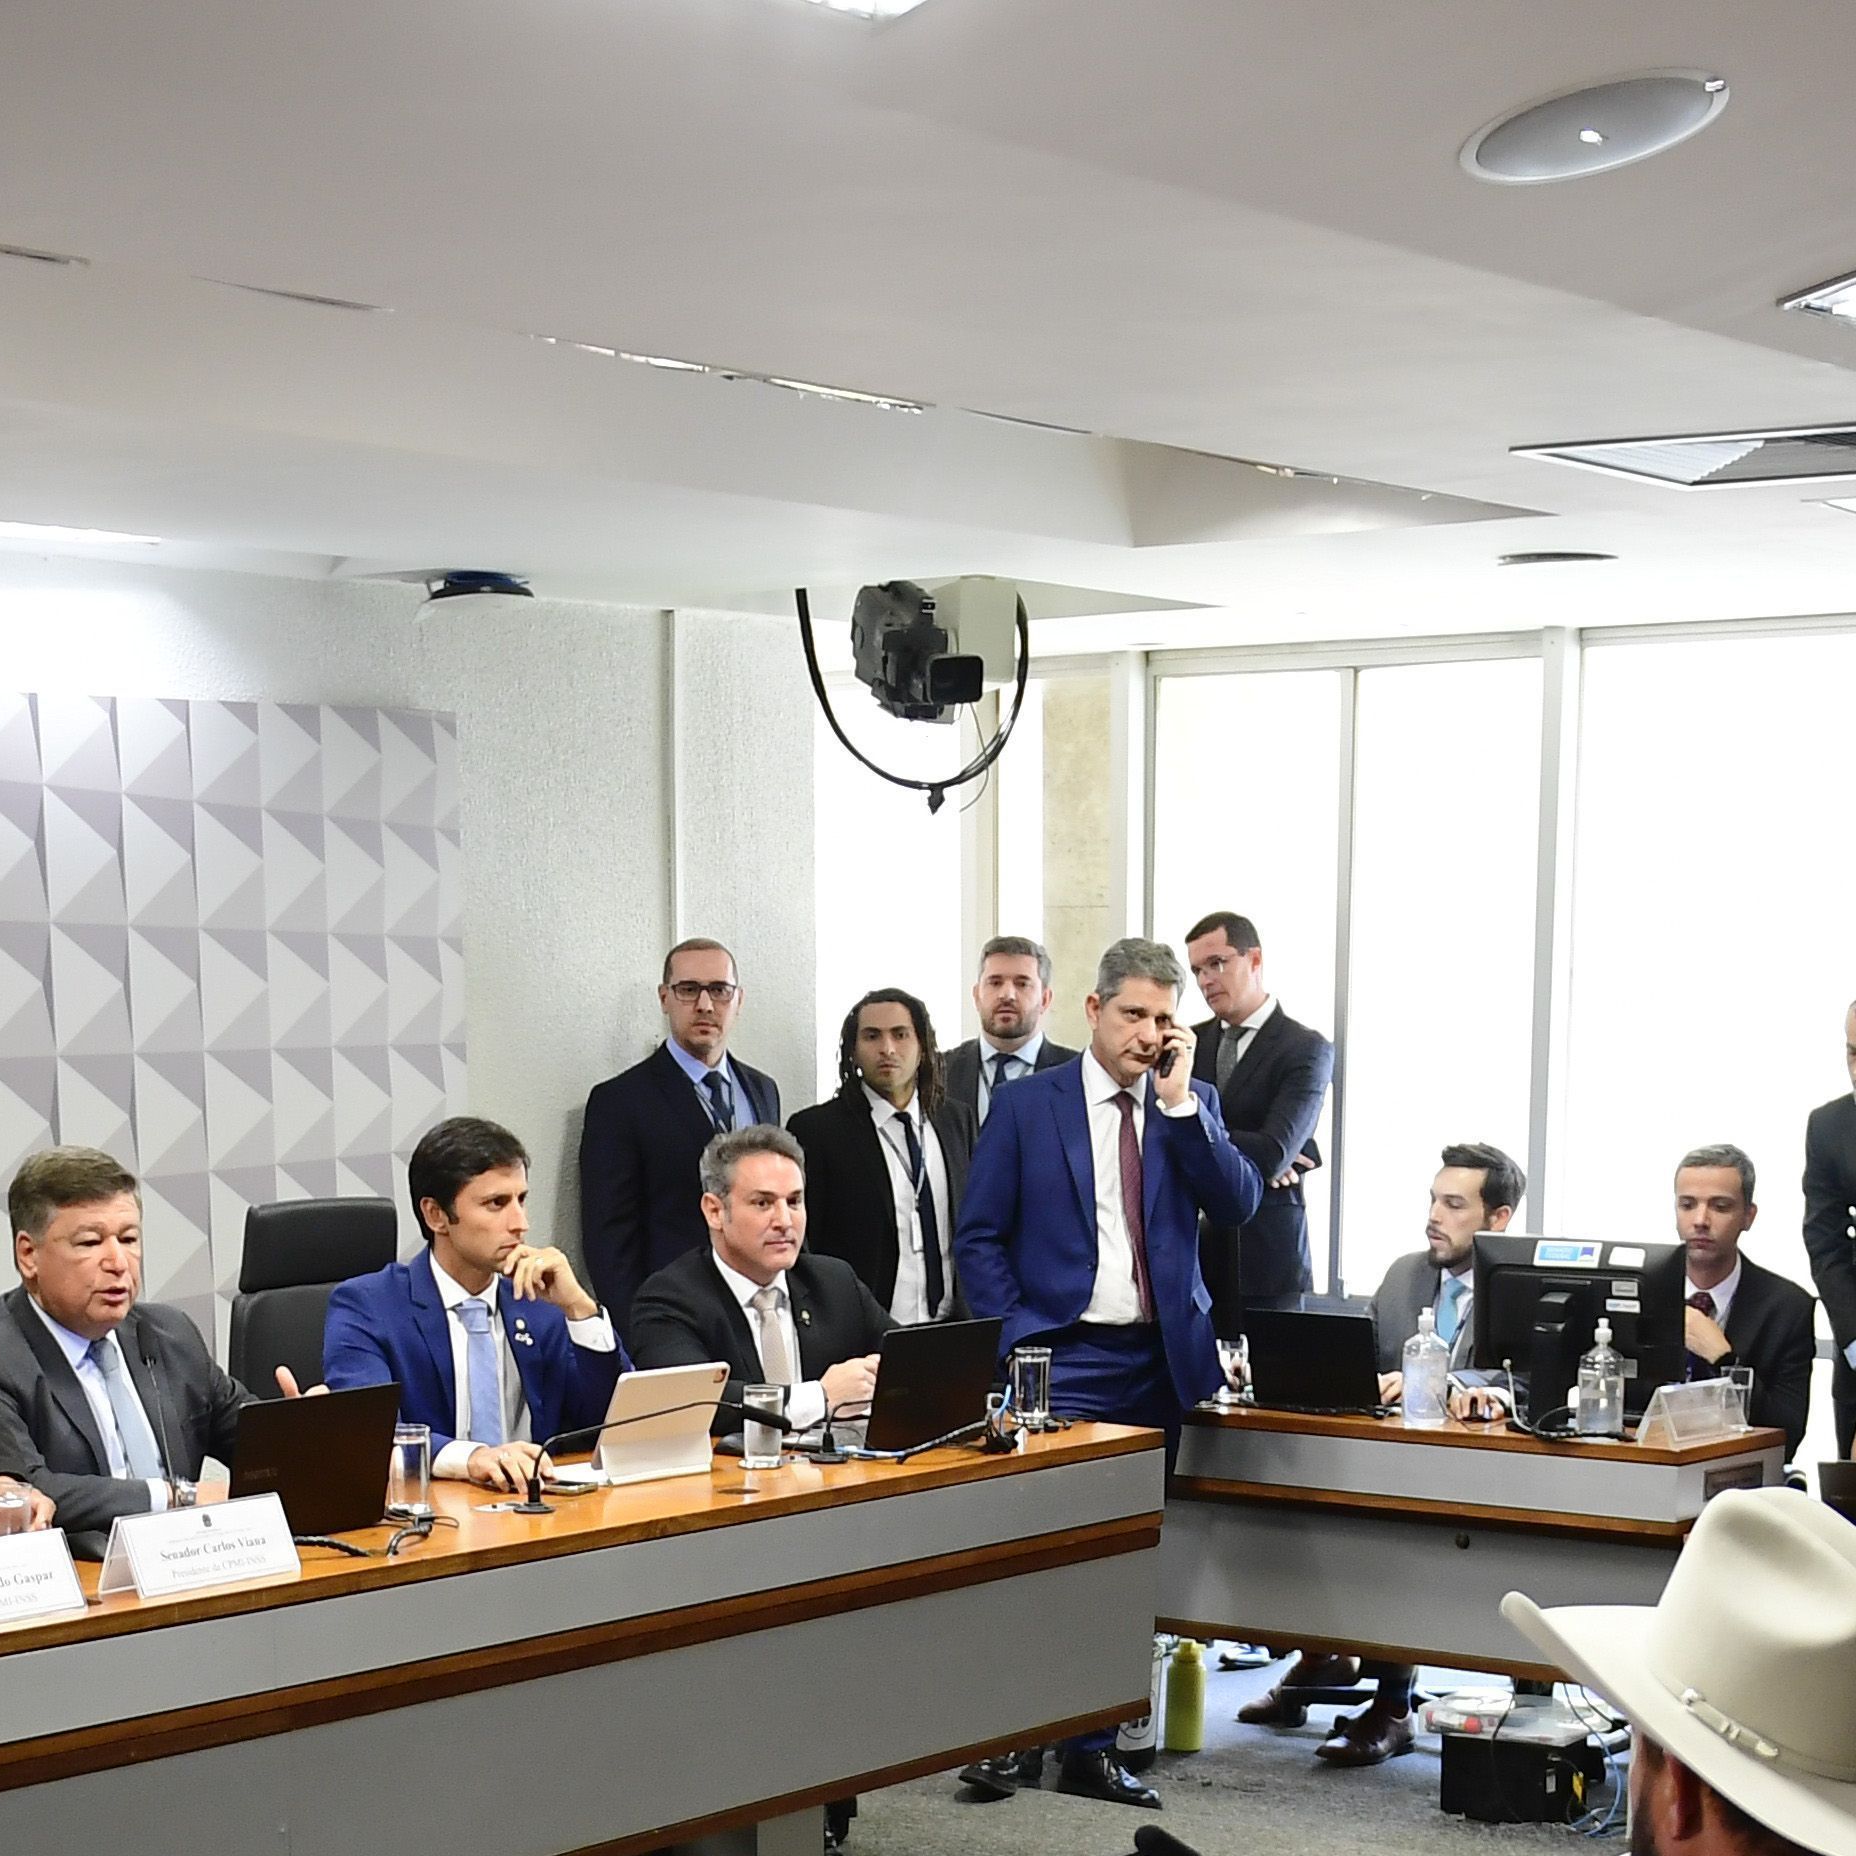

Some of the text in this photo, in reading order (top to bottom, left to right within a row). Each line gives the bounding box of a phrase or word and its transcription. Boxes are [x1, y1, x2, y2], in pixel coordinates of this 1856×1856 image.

[159, 1534, 267, 1562] Senador Carlos Viana
[13, 1570, 54, 1586] Gaspar
